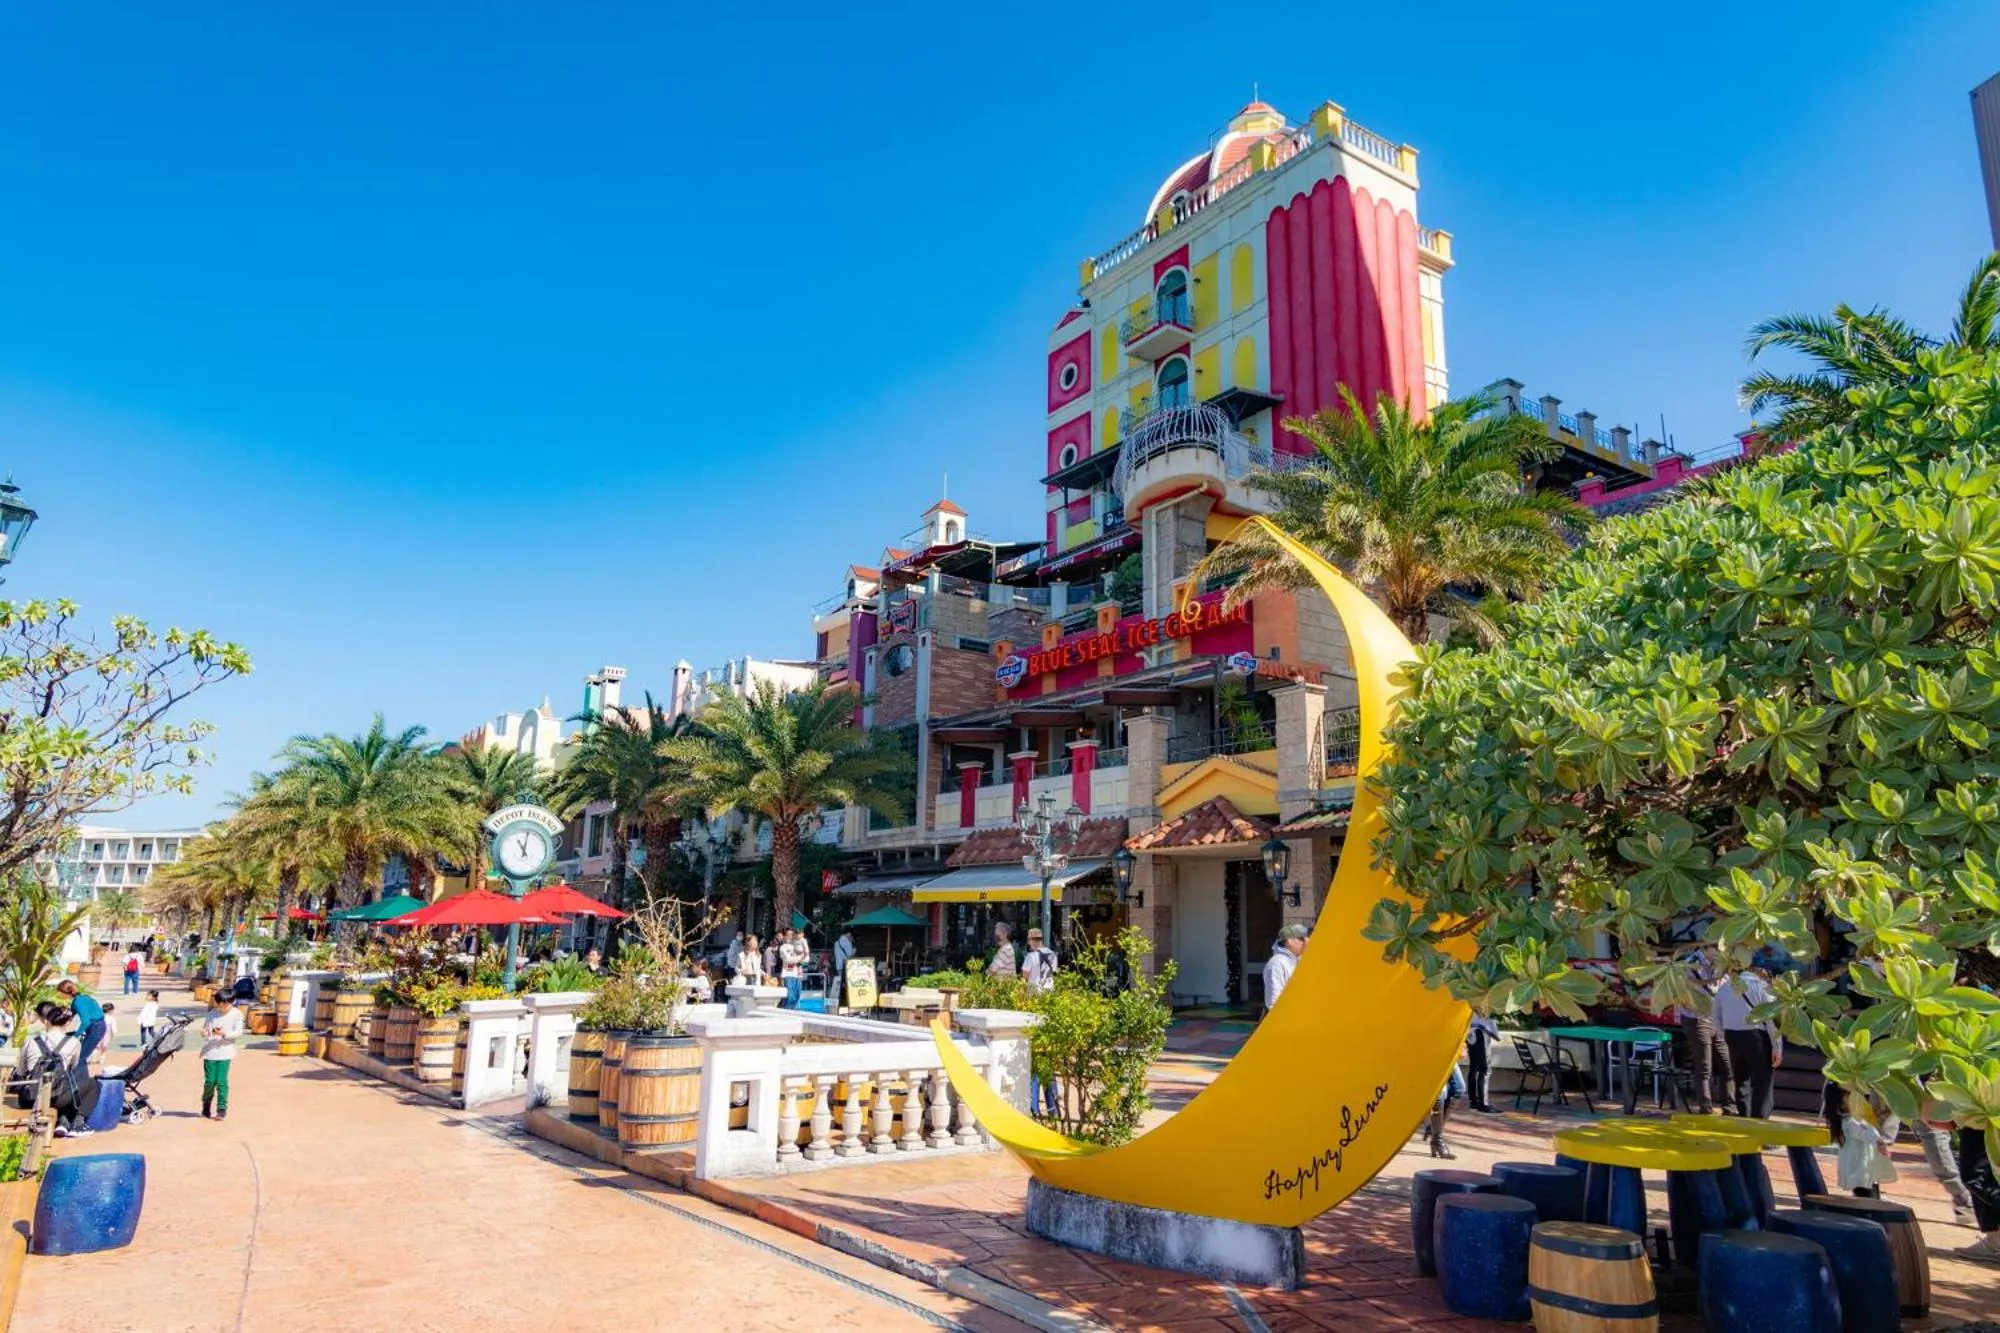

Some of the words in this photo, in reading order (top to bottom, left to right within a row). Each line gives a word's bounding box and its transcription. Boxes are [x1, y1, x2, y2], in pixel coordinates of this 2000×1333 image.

[1029, 646, 1072, 677] BLUE
[1076, 633, 1122, 664] SEAL
[1127, 618, 1159, 648] ICE
[1264, 1147, 1342, 1200] Happy
[1339, 1083, 1389, 1147] Luna
